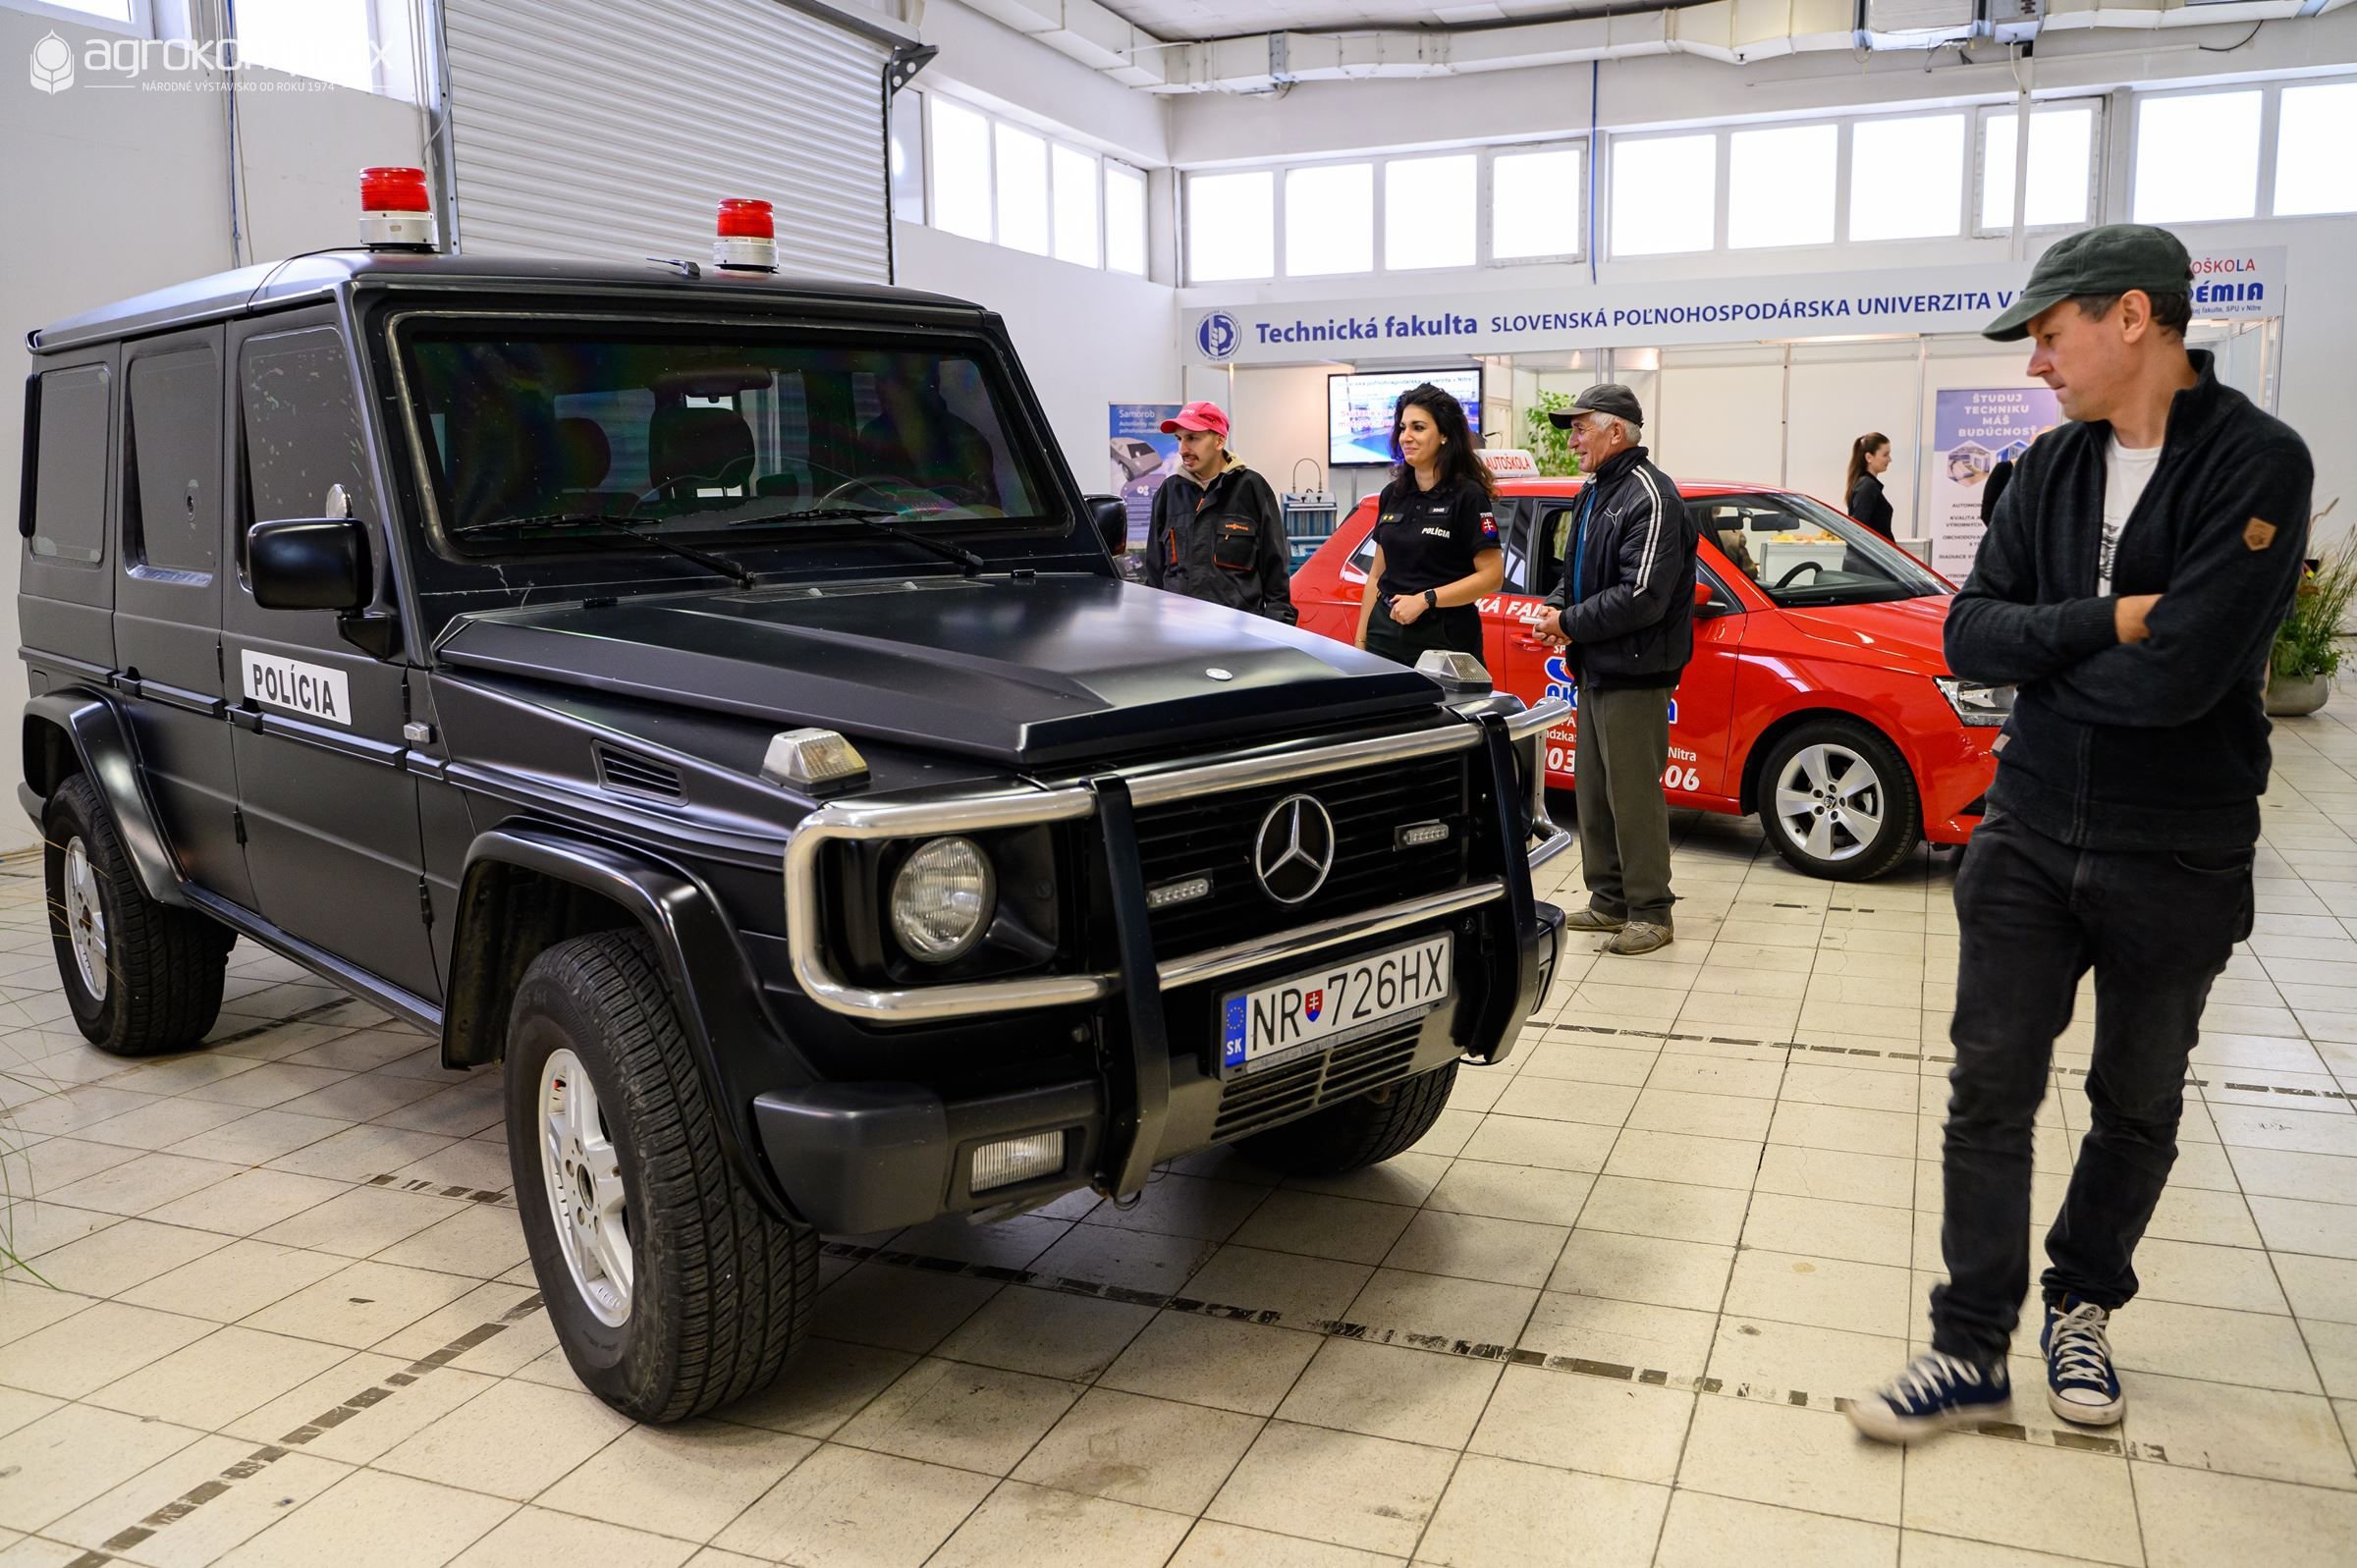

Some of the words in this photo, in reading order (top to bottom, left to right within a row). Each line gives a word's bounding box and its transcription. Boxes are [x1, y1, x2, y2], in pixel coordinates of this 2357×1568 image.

[2191, 257, 2256, 274] OŠKOLA
[2189, 280, 2264, 303] ÉMIA
[1255, 316, 1378, 344] Technická
[1385, 313, 1477, 337] fakulta
[1491, 307, 1608, 333] SLOVENSKÁ
[1614, 297, 1850, 327] POĽNOHOSPODÁRSKA
[1857, 293, 1992, 315] UNIVERZITA
[1972, 393, 2023, 404] ŠTUDUJ
[1119, 408, 1155, 418] Samorob
[1964, 405, 2029, 414] TECHNIKU
[1982, 414, 2010, 425] MÁŠ
[1958, 425, 2038, 437] BUDÚCNOSŤ
[1485, 454, 1532, 470] AUTOŠKOLA
[1421, 526, 1451, 539] POLÍCIA
[1474, 596, 1502, 614] KÁ
[252, 664, 336, 718] POLÍCIA
[1668, 746, 1697, 762] Nitra
[1660, 764, 1700, 791] 06
[1252, 988, 1302, 1052] NR
[1328, 944, 1445, 1027] 726HX
[1226, 1037, 1242, 1056] SK
